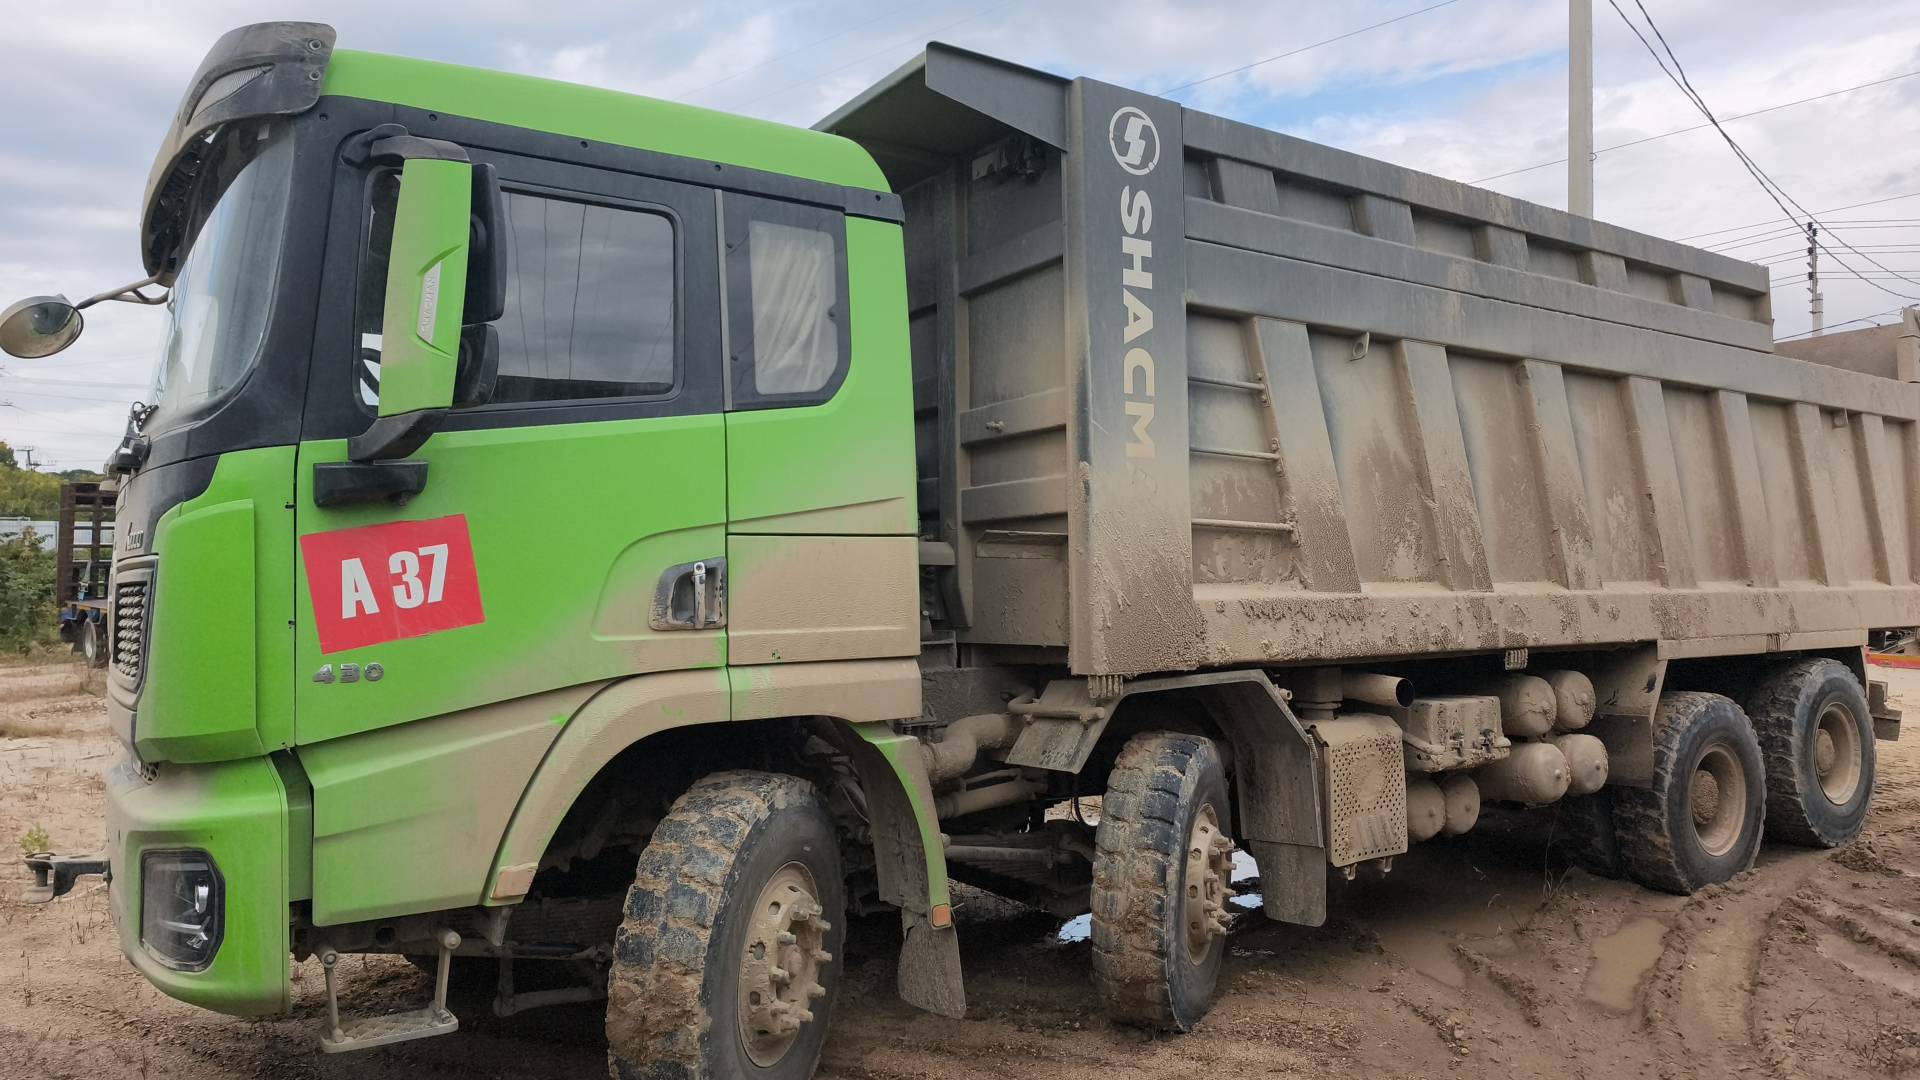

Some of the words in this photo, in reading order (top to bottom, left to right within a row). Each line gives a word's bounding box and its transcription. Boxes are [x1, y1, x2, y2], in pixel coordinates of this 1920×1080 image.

[341, 557, 380, 619] A
[388, 543, 449, 609] 37
[312, 662, 385, 684] 430
